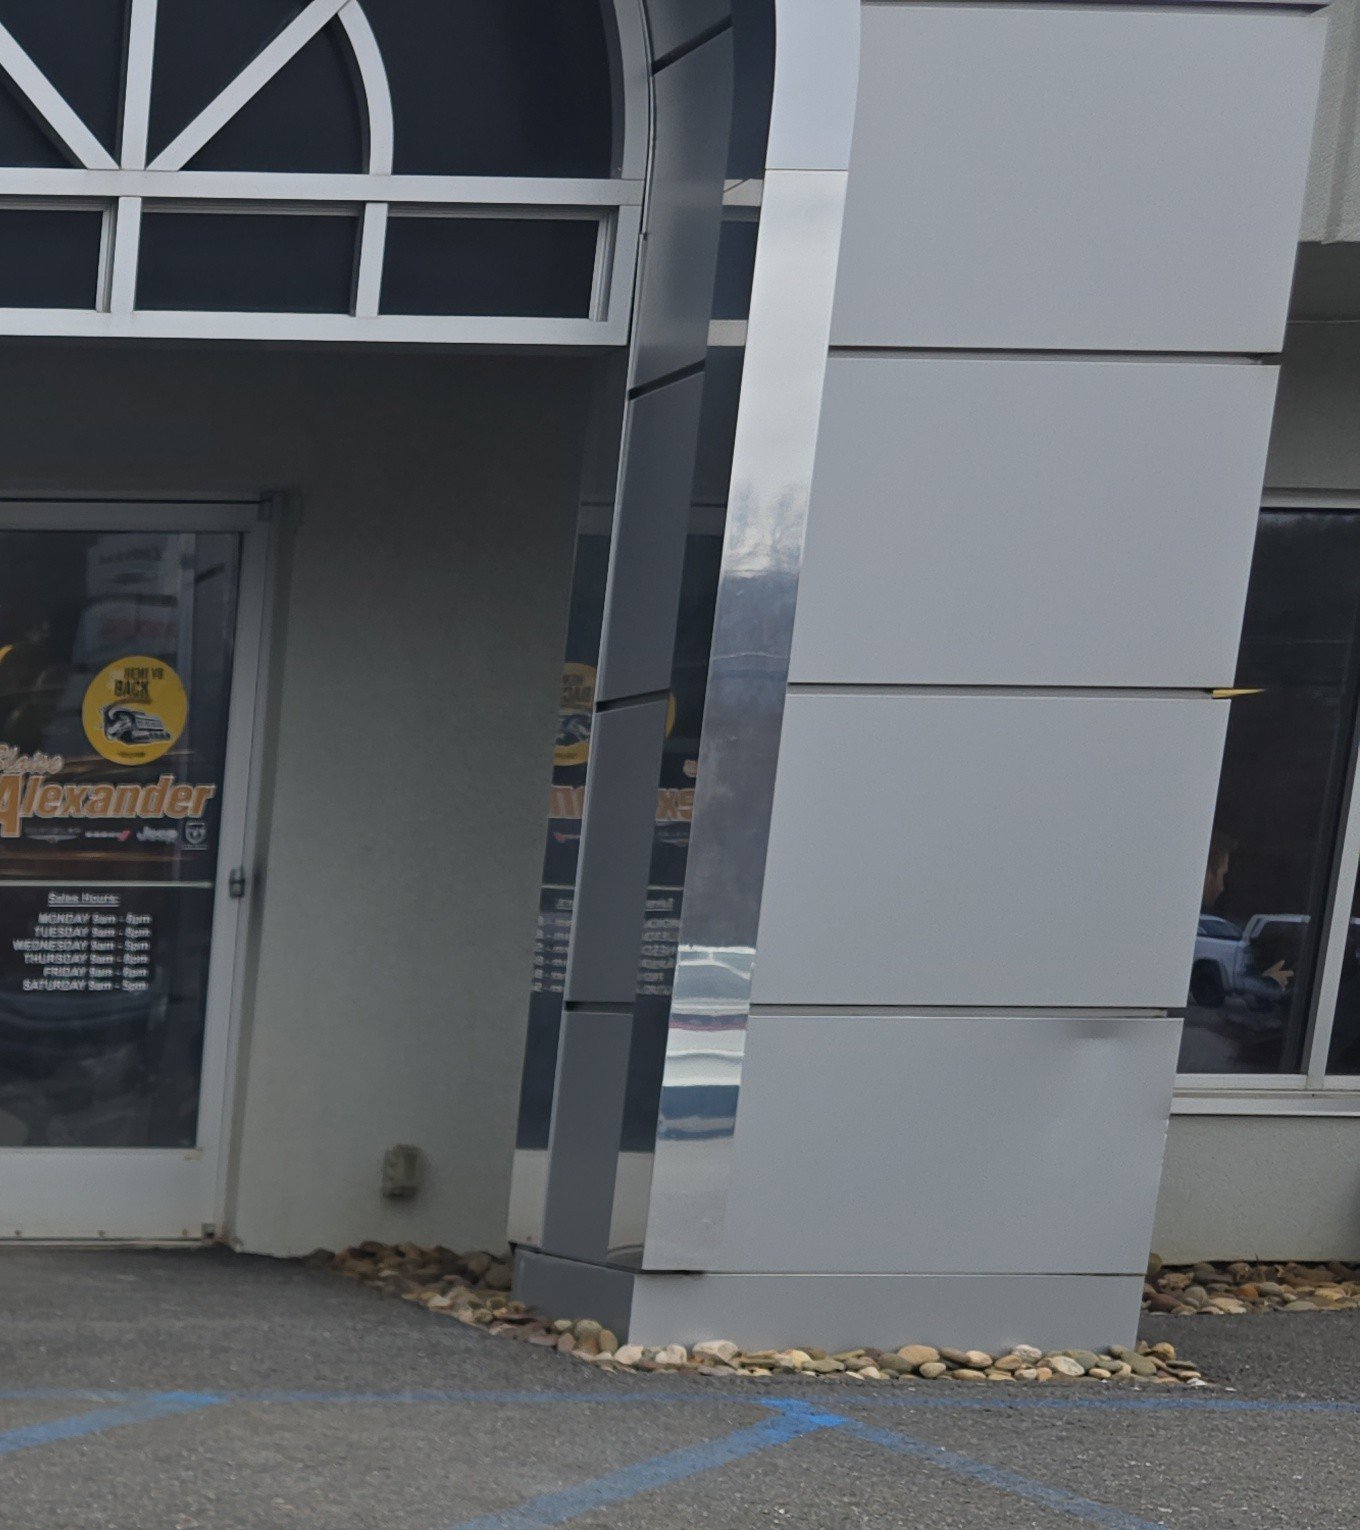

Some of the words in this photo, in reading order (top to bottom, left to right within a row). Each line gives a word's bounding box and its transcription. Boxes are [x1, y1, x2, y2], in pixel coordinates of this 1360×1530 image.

[38, 912, 90, 924] MONDAY
[34, 926, 89, 938] TUESDAY
[12, 939, 89, 951] WEDNESDAY
[24, 952, 88, 965] THURSDAY
[42, 966, 87, 978] FRIDAY
[22, 979, 87, 991] SATURDAY
